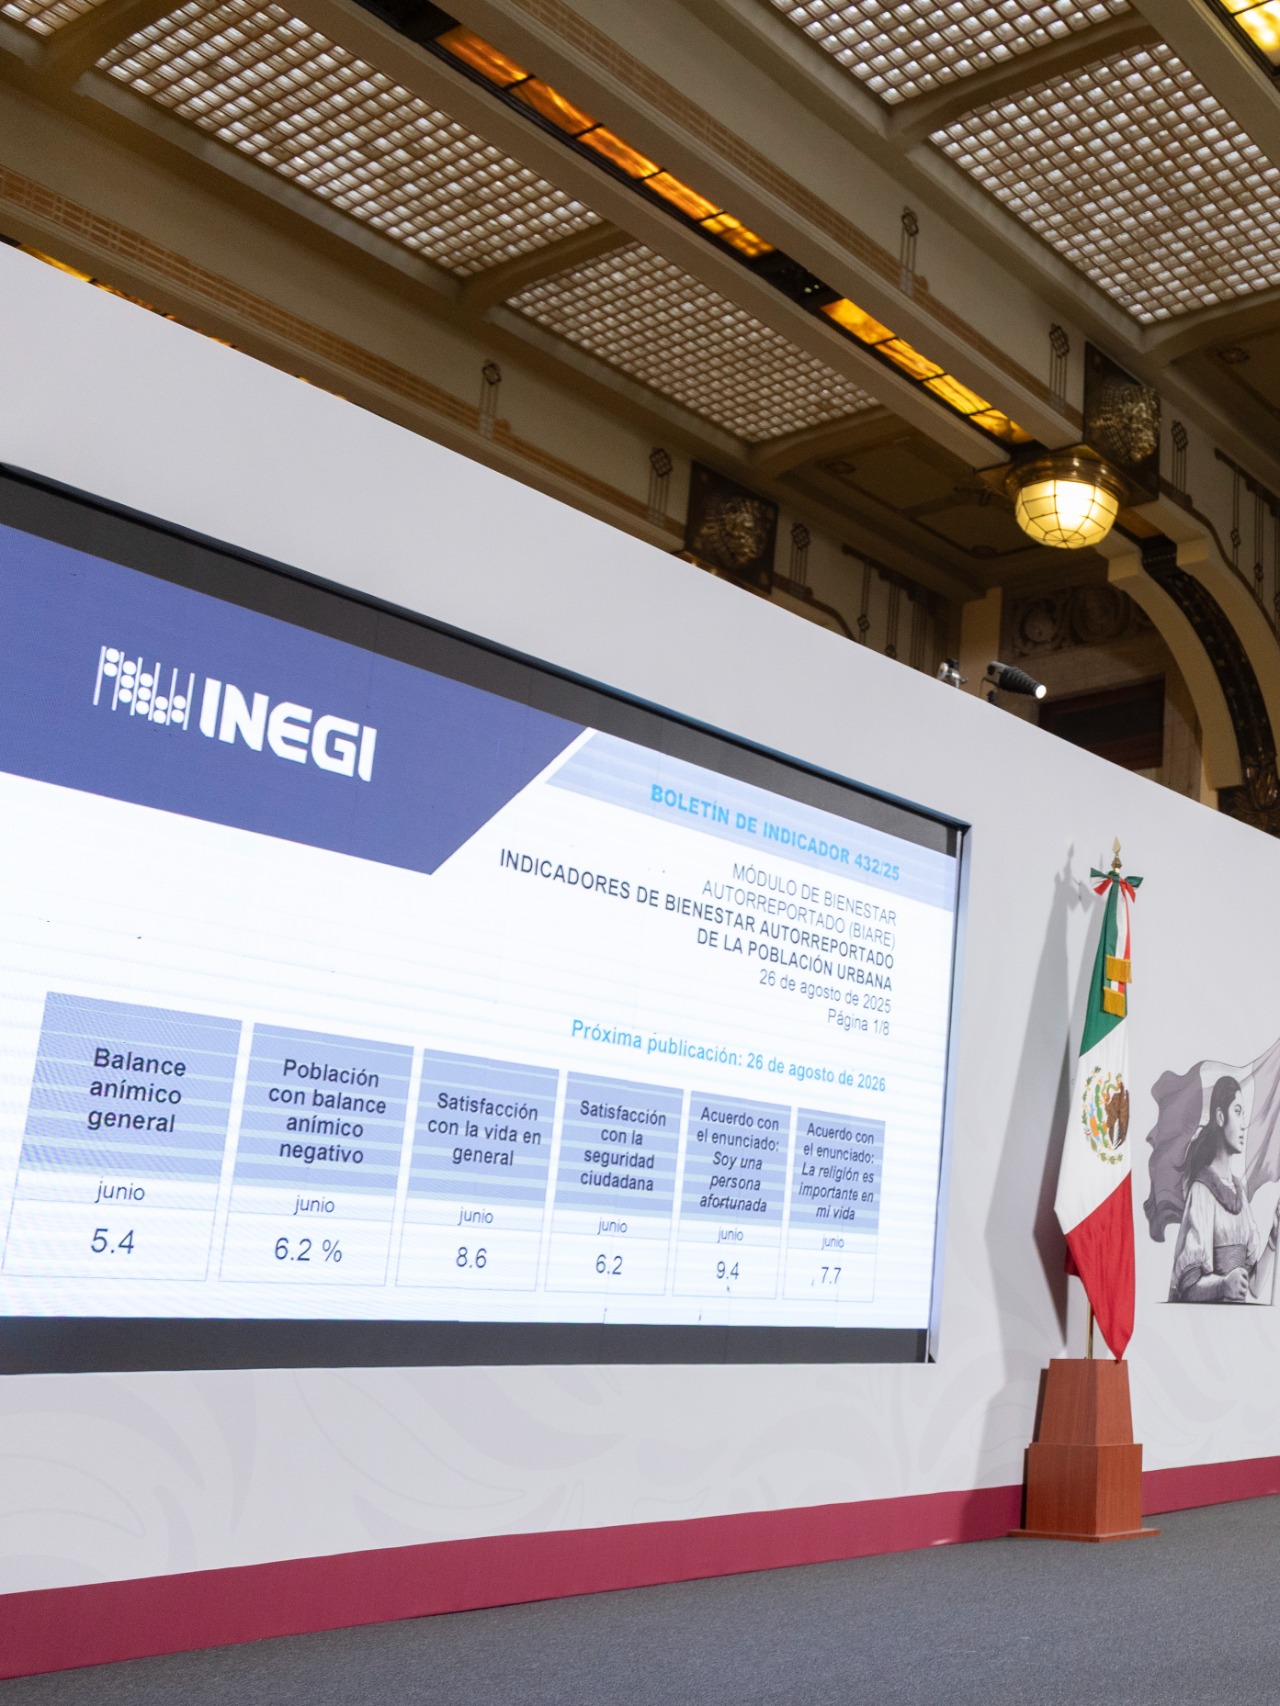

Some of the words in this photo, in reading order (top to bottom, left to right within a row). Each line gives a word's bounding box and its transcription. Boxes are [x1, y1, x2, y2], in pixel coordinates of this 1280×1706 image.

[200, 677, 377, 782] INEGI
[650, 784, 730, 825] BOLETÍN
[735, 812, 757, 834] DE
[762, 821, 850, 865] INDICADOR
[854, 852, 900, 881] 432/25
[732, 863, 797, 896] MÓDULO
[801, 884, 820, 903] DE
[824, 891, 897, 926] BIENESTAR
[499, 848, 631, 899] INDICADORES
[636, 886, 659, 907] DE
[664, 893, 756, 933] BIENESTAR
[760, 920, 894, 970] AUTORREPORTADO
[702, 879, 846, 935] AUTORREPORTADO
[849, 922, 895, 950] (BIARE)
[697, 927, 719, 948] DE
[724, 933, 744, 954] LA
[748, 940, 833, 977] POBLACIÓN
[837, 962, 892, 992] URBANA
[760, 968, 776, 986] 26
[780, 975, 796, 991] de
[800, 981, 841, 1002] agosto
[845, 990, 859, 1006] de
[863, 993, 891, 1013] 2025
[827, 1009, 868, 1032] Página
[873, 1017, 890, 1037] 1/8
[93, 1048, 186, 1077] Balance
[572, 1020, 643, 1050] Próxima
[647, 1034, 743, 1066] publicación:
[746, 1052, 764, 1070] 26
[768, 1056, 785, 1074] de
[788, 1062, 835, 1083] agosto
[838, 1068, 854, 1086] de
[857, 1073, 886, 1092] 2026
[283, 1059, 380, 1089] Población
[90, 1078, 182, 1105] anímico
[268, 1087, 306, 1106] con
[312, 1090, 387, 1115] balance
[437, 1092, 539, 1121] Satisfacción
[579, 1100, 666, 1126] Satisfacción
[87, 1108, 175, 1133] general
[286, 1114, 364, 1138] anímico
[701, 1107, 754, 1127] Acuerdo
[757, 1118, 779, 1131] con
[427, 1118, 459, 1136] con
[464, 1120, 480, 1137] la
[484, 1121, 518, 1141] vida
[522, 1128, 541, 1146] en
[600, 1127, 627, 1143] con
[631, 1128, 643, 1145] la
[697, 1129, 708, 1143] el
[712, 1132, 779, 1152] enunciado:
[807, 1123, 853, 1141] Acuerdo
[855, 1132, 875, 1144] con
[279, 1141, 364, 1164] negativo
[452, 1145, 514, 1166] general
[583, 1148, 655, 1170] seguridad
[712, 1152, 737, 1170] Soy
[740, 1157, 763, 1170] una
[804, 1144, 813, 1156] el
[817, 1146, 875, 1164] enunciado:
[580, 1171, 654, 1191] ciudadana
[709, 1175, 761, 1191] persona
[801, 1162, 815, 1176] La
[818, 1165, 859, 1182] religión
[862, 1172, 875, 1184] es
[95, 1180, 145, 1203] junio
[699, 1193, 767, 1213] afortunada
[798, 1182, 858, 1201] importante
[861, 1191, 874, 1203] en
[294, 1194, 335, 1216] junio
[457, 1207, 494, 1225] junio
[816, 1205, 830, 1218] mi
[833, 1207, 855, 1220] vida
[598, 1218, 628, 1235] junio
[717, 1226, 744, 1243] junio
[90, 1228, 135, 1255] 5.4
[274, 1237, 312, 1262] 6.2
[322, 1239, 343, 1263] %
[822, 1234, 845, 1250] junio
[456, 1246, 487, 1269] 8.6
[595, 1254, 623, 1276] 6.2
[716, 1260, 739, 1280] 9.4
[821, 1266, 842, 1284] 7.7
